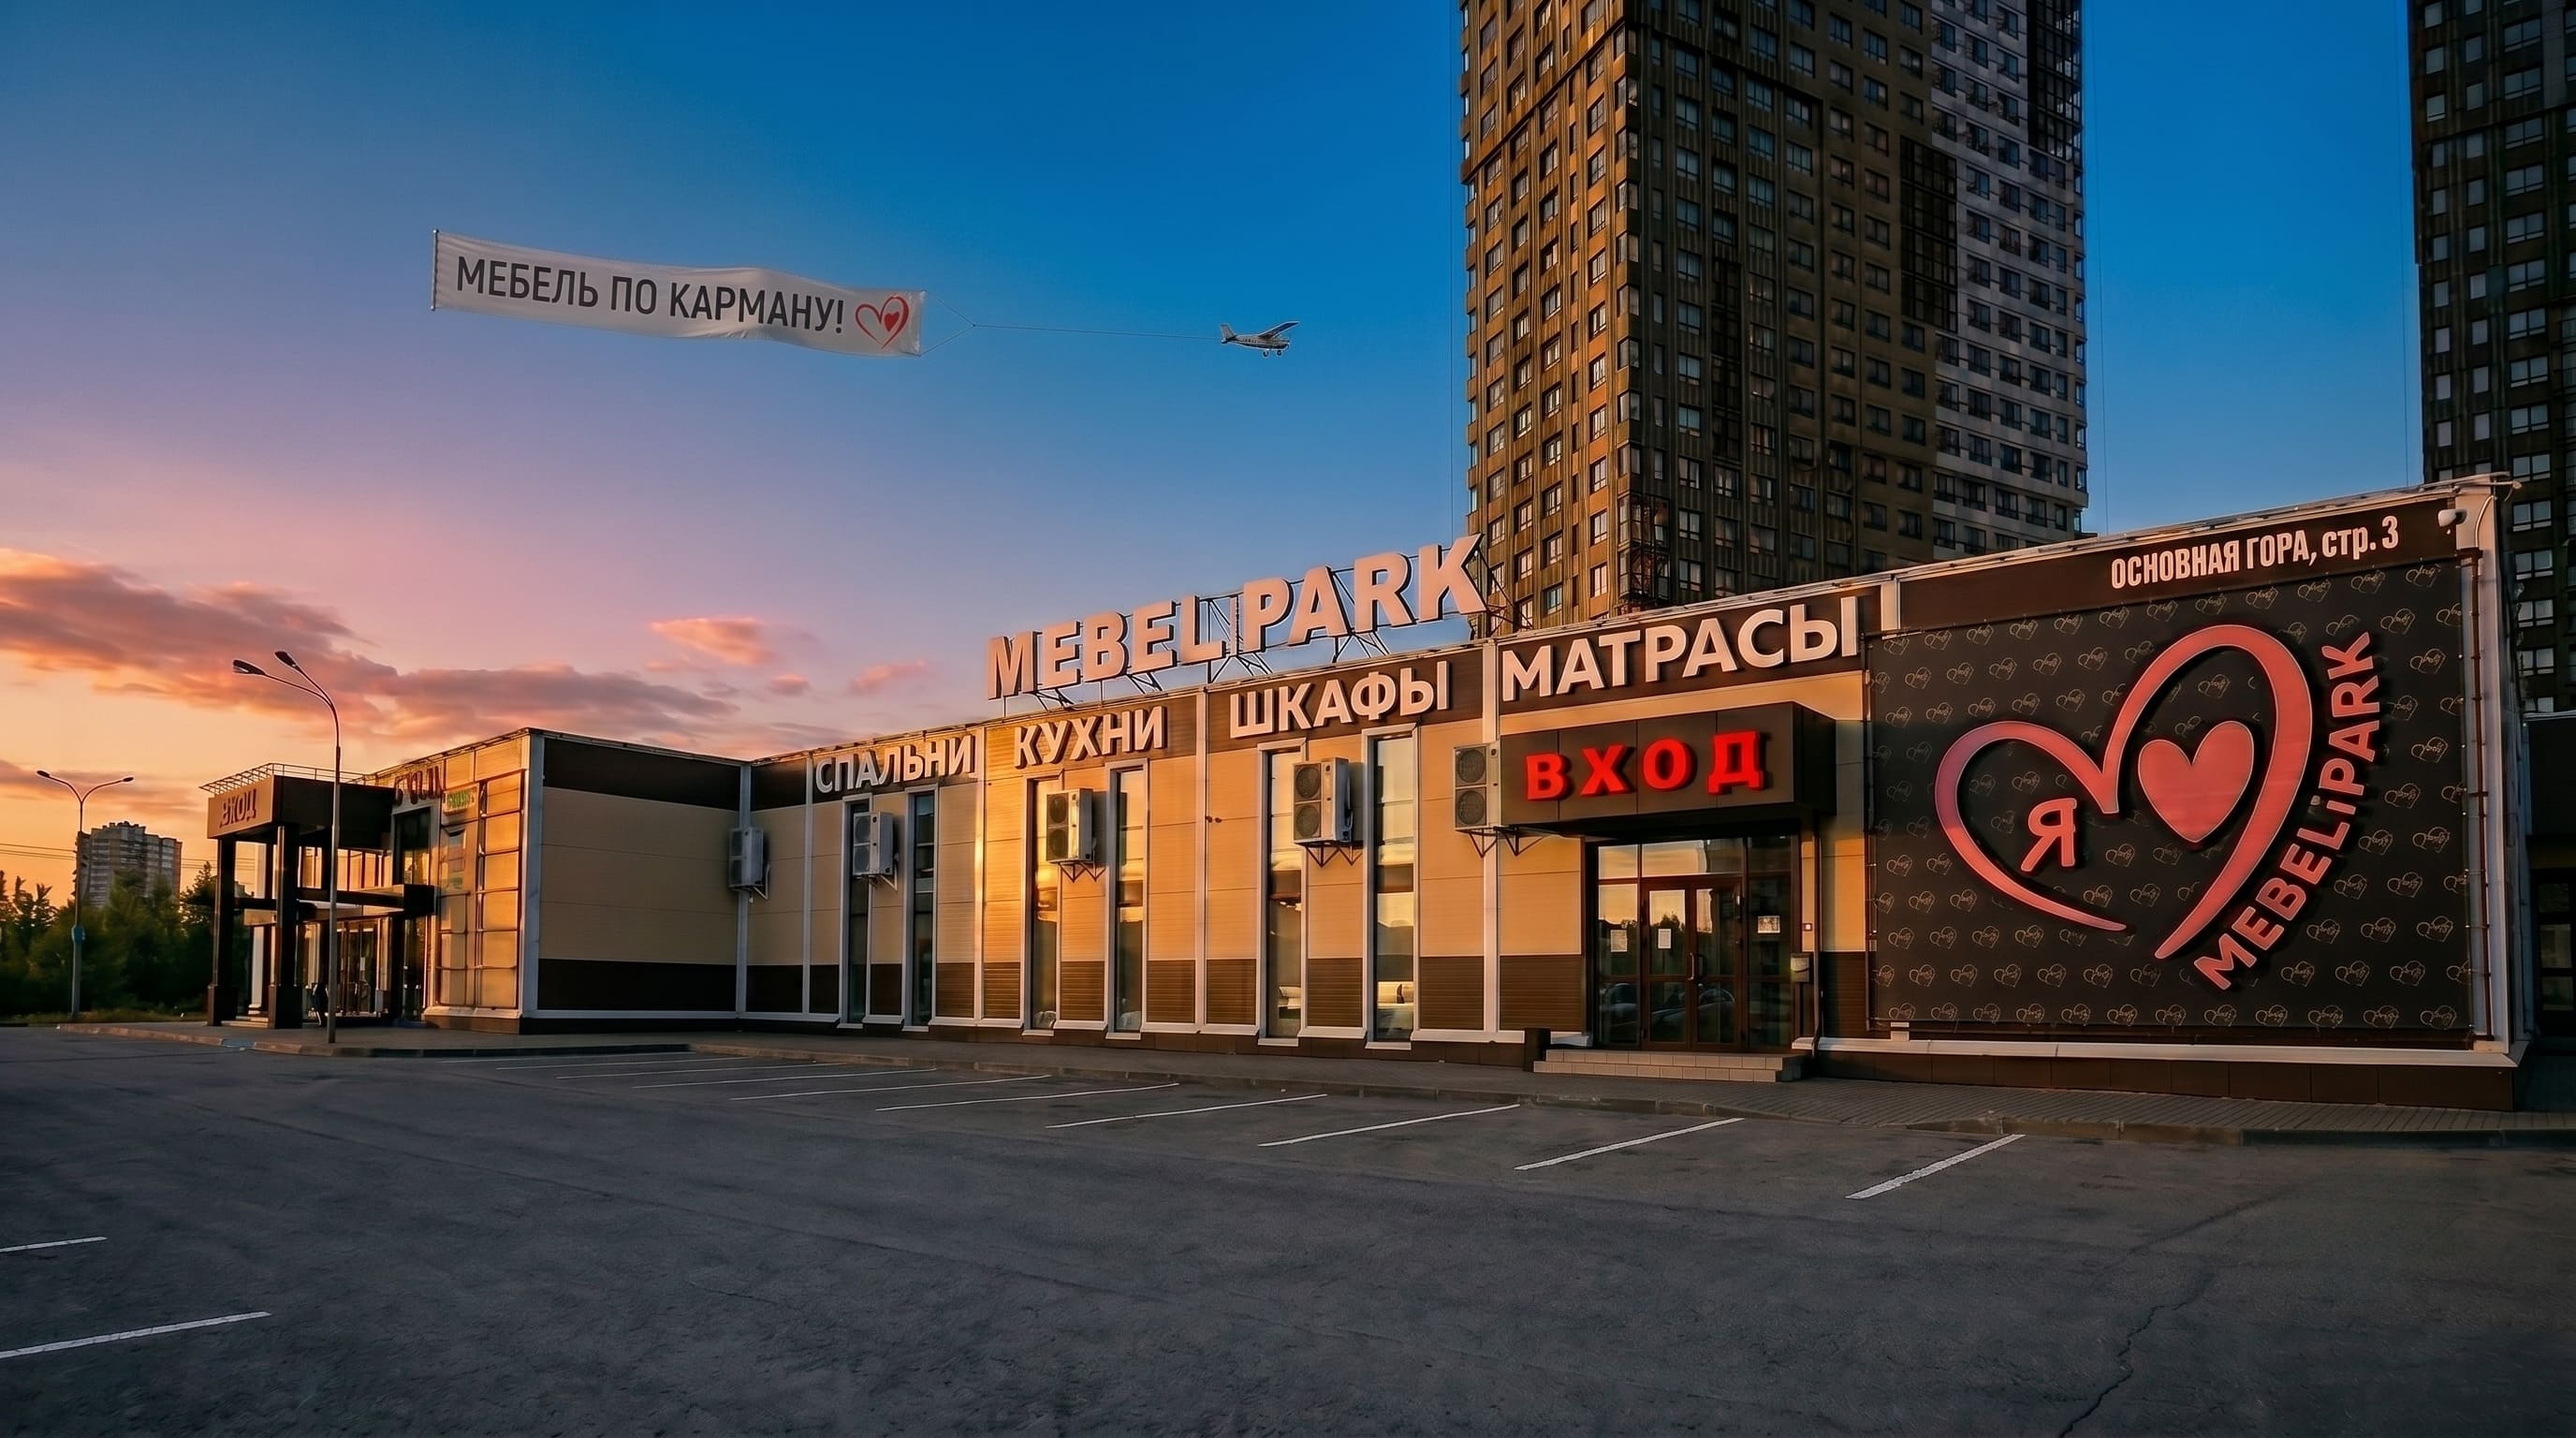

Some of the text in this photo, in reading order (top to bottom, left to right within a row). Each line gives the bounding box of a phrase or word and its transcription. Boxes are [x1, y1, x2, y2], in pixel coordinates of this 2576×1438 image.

[457, 256, 845, 333] МЕБЕЛЬ ПО КАРМАНУ!
[2111, 515, 2400, 590] ОСНОВНАЯ ГОРА, стр. 3
[1500, 595, 1859, 702] МАТРАСЫ
[1013, 705, 1168, 769] КУХНИ
[1229, 659, 1452, 740] ШКАФЫ
[814, 734, 977, 794] СПАЛЬНИ
[1525, 728, 1767, 801] ВХОД
[2020, 797, 2078, 873] Я
